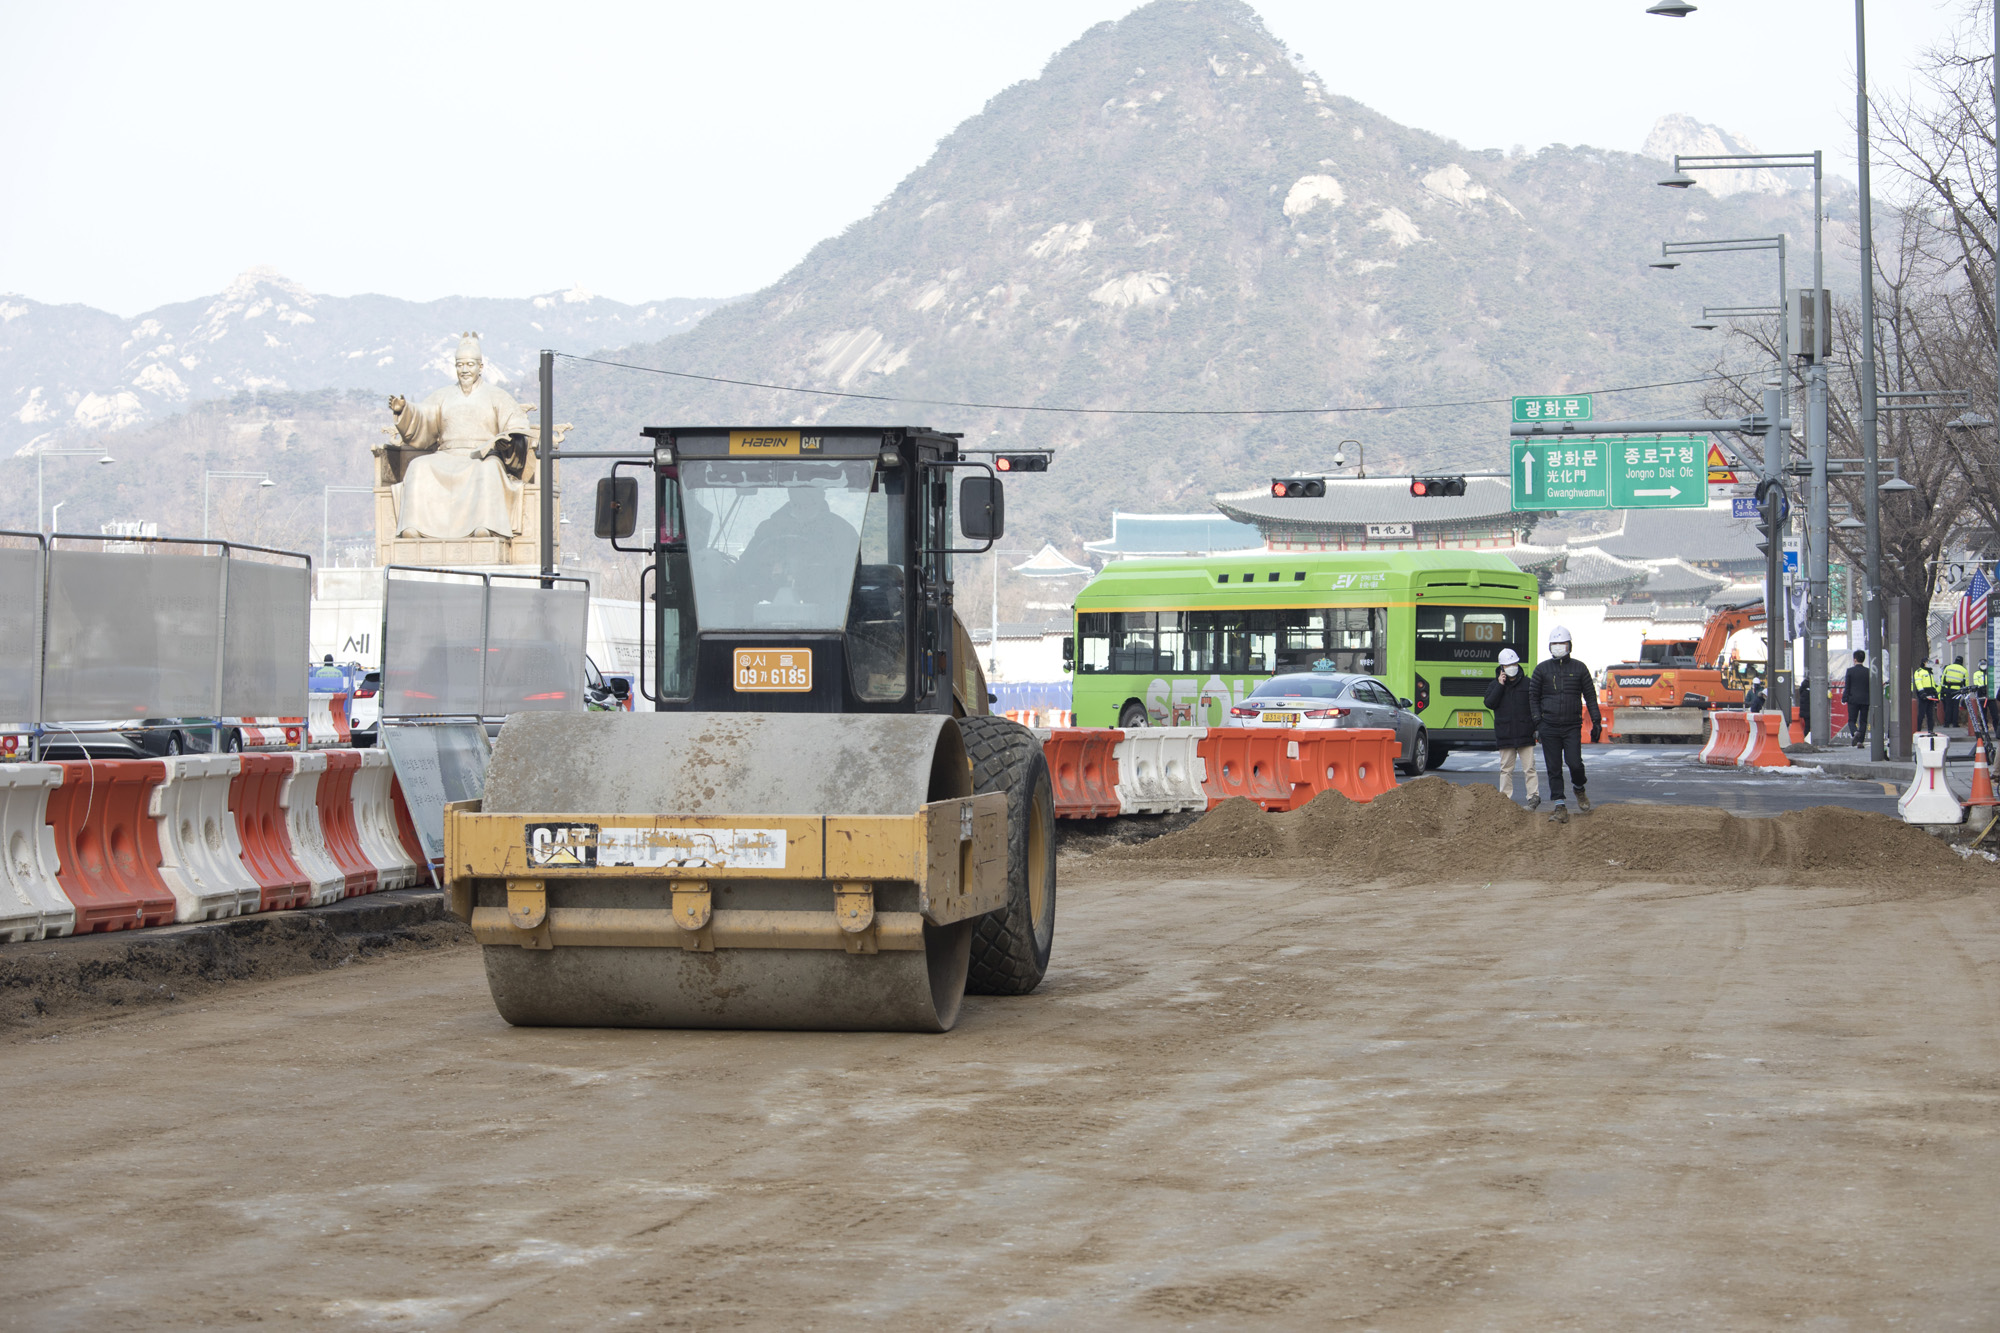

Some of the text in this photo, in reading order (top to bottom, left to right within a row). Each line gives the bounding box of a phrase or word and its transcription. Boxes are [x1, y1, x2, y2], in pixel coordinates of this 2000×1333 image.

[1525, 400, 1580, 418] 광화문
[801, 436, 821, 449] CAT
[1547, 450, 1598, 467] 광화문
[1624, 446, 1694, 465] 종로구청
[1546, 469, 1586, 483] 光化門
[1625, 466, 1694, 481] Jongno Dist Ofc
[1547, 487, 1605, 500] Gwanghwamun
[1475, 624, 1493, 641] 03
[1619, 678, 1653, 686] DOOSAN
[532, 827, 590, 864] CAT
